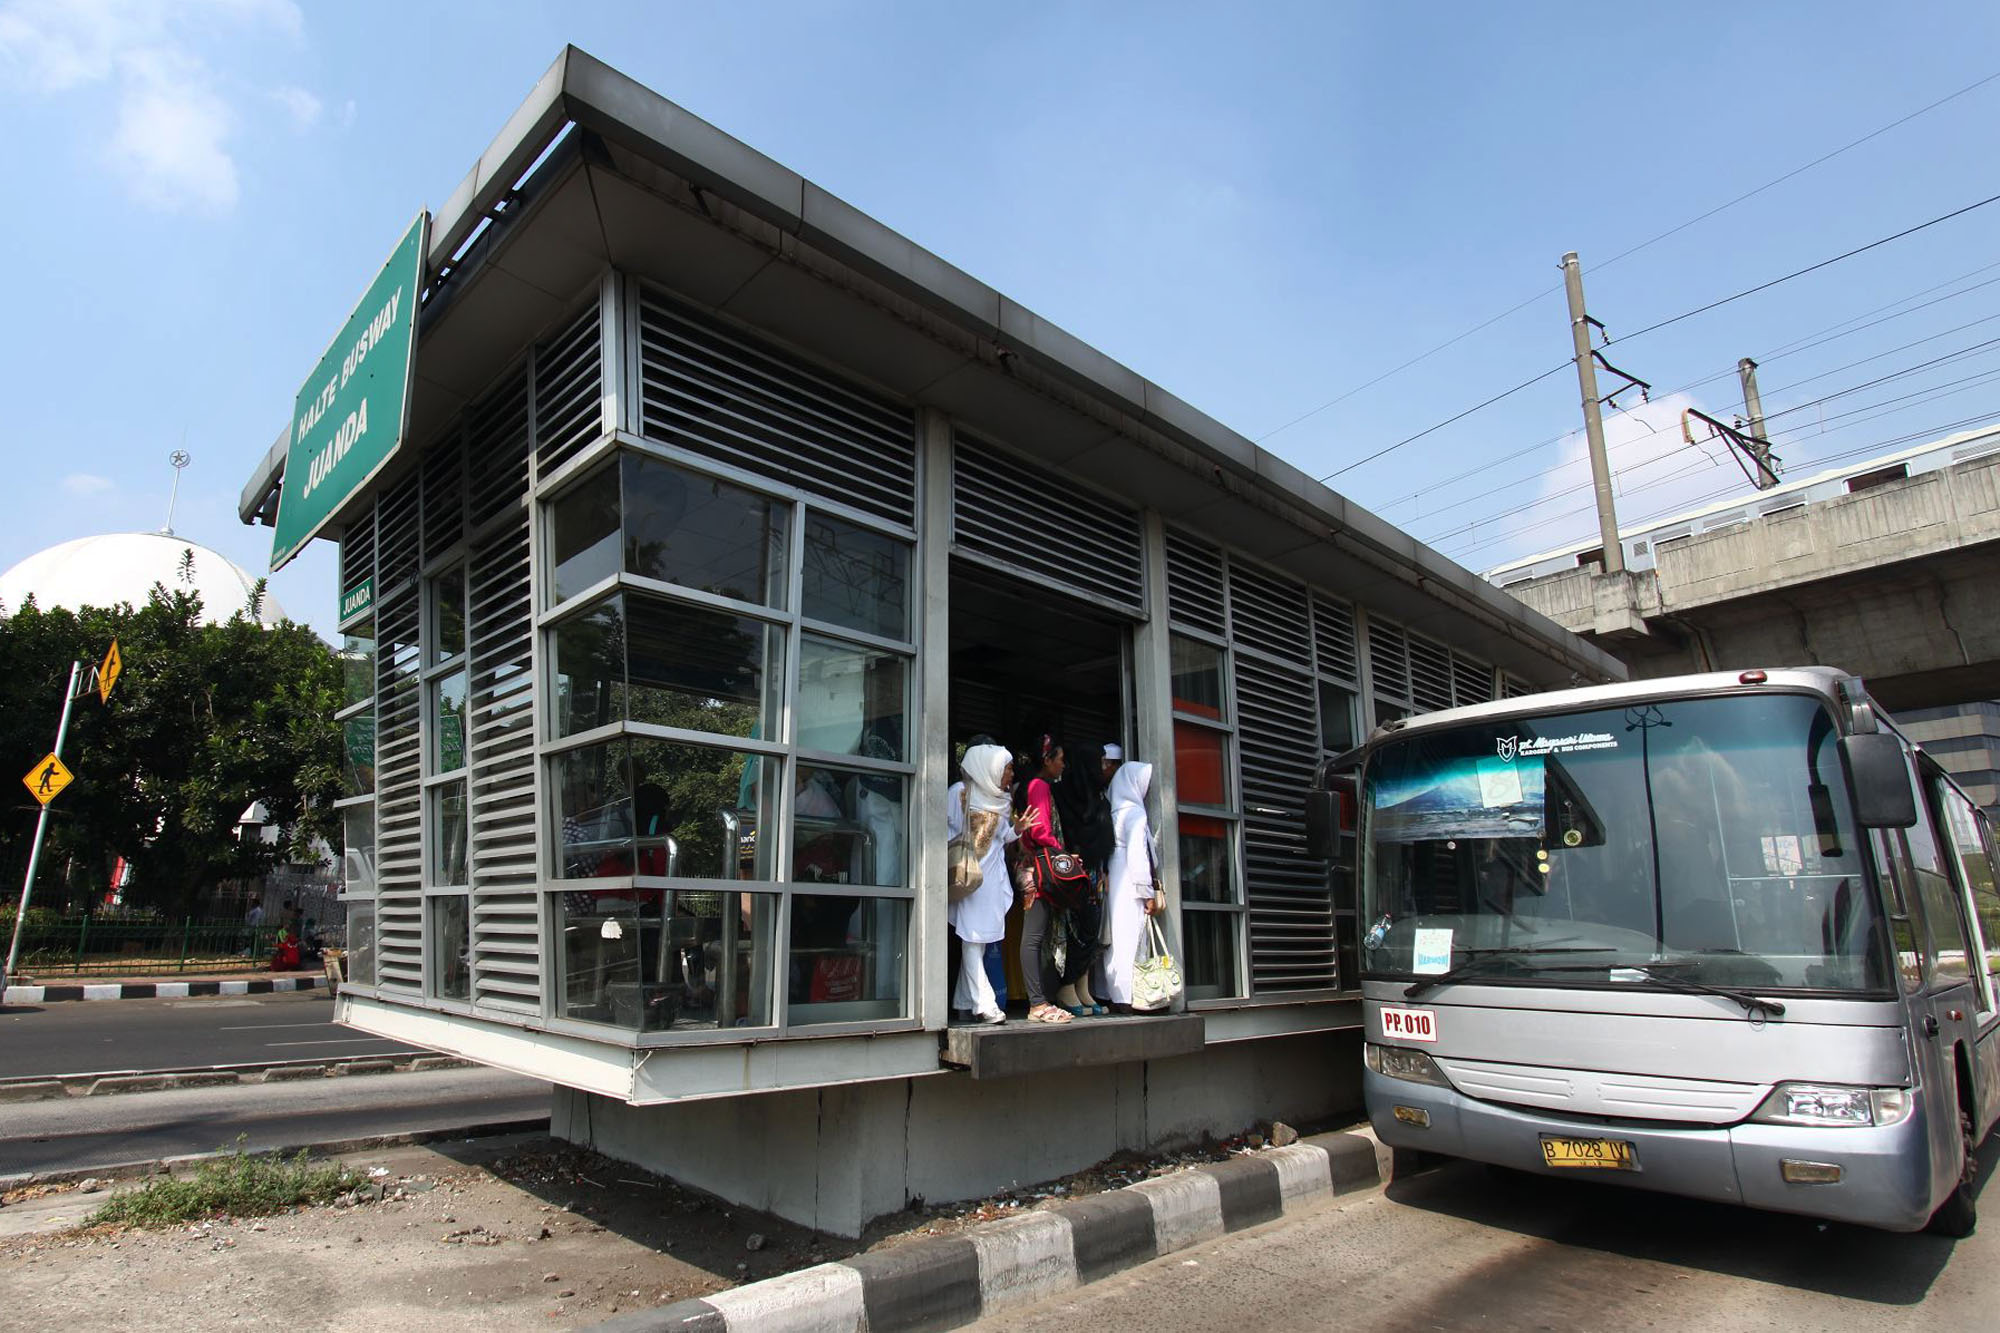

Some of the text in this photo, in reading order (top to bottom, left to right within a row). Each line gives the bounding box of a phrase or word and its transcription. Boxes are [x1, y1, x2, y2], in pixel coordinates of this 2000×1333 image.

[297, 285, 403, 444] HALTE BUSWAY
[303, 397, 368, 500] JUANDA
[343, 584, 371, 616] JUANDA
[1574, 740, 1619, 751] COMPONENTS
[1544, 1141, 1557, 1158] B
[1562, 1140, 1603, 1158] 7028
